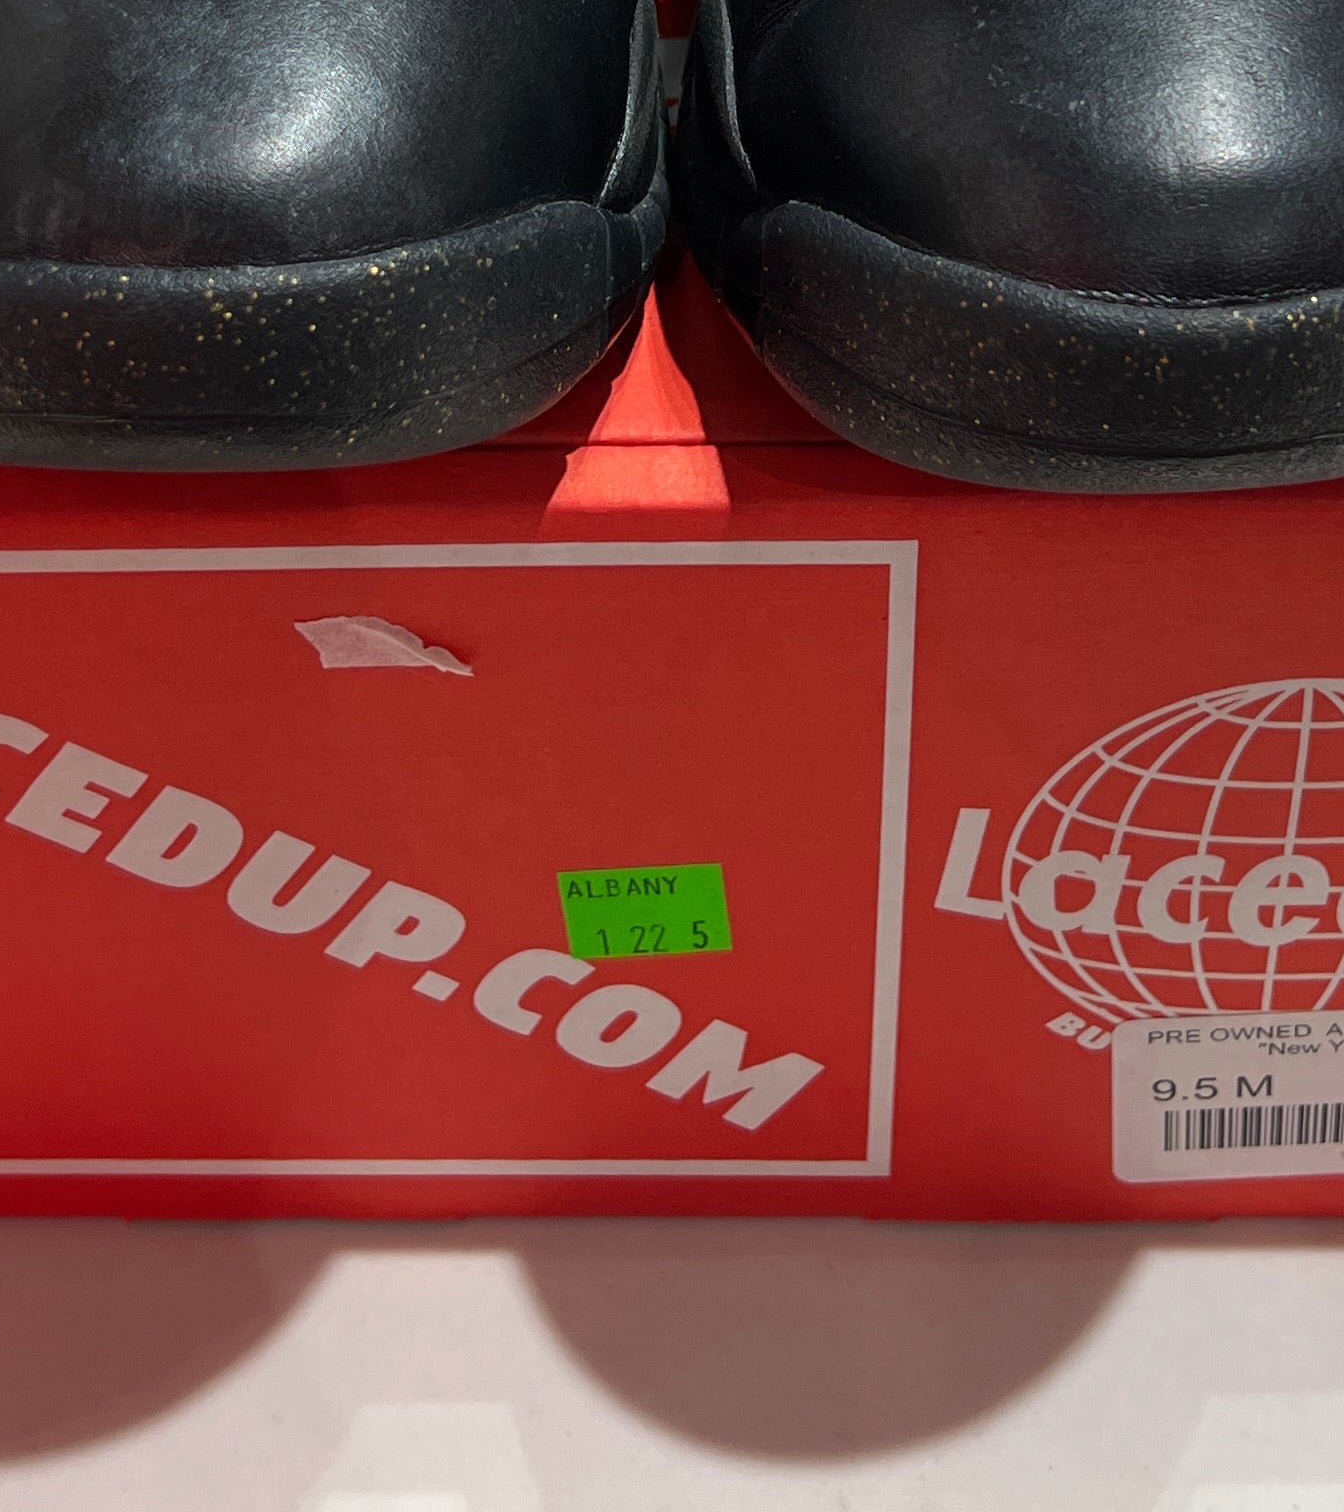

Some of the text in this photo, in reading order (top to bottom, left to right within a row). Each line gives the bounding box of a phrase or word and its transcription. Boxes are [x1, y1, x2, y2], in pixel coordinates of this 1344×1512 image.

[566, 875, 679, 900] ALBANY
[596, 920, 709, 955] 1 22 5
[1045, 1011, 1112, 1050] BU
[1148, 1029, 1201, 1044] PRE
[1210, 1023, 1312, 1042] OWNED
[1258, 1040, 1322, 1056] "New
[1152, 1074, 1273, 1102] 9.5 M
